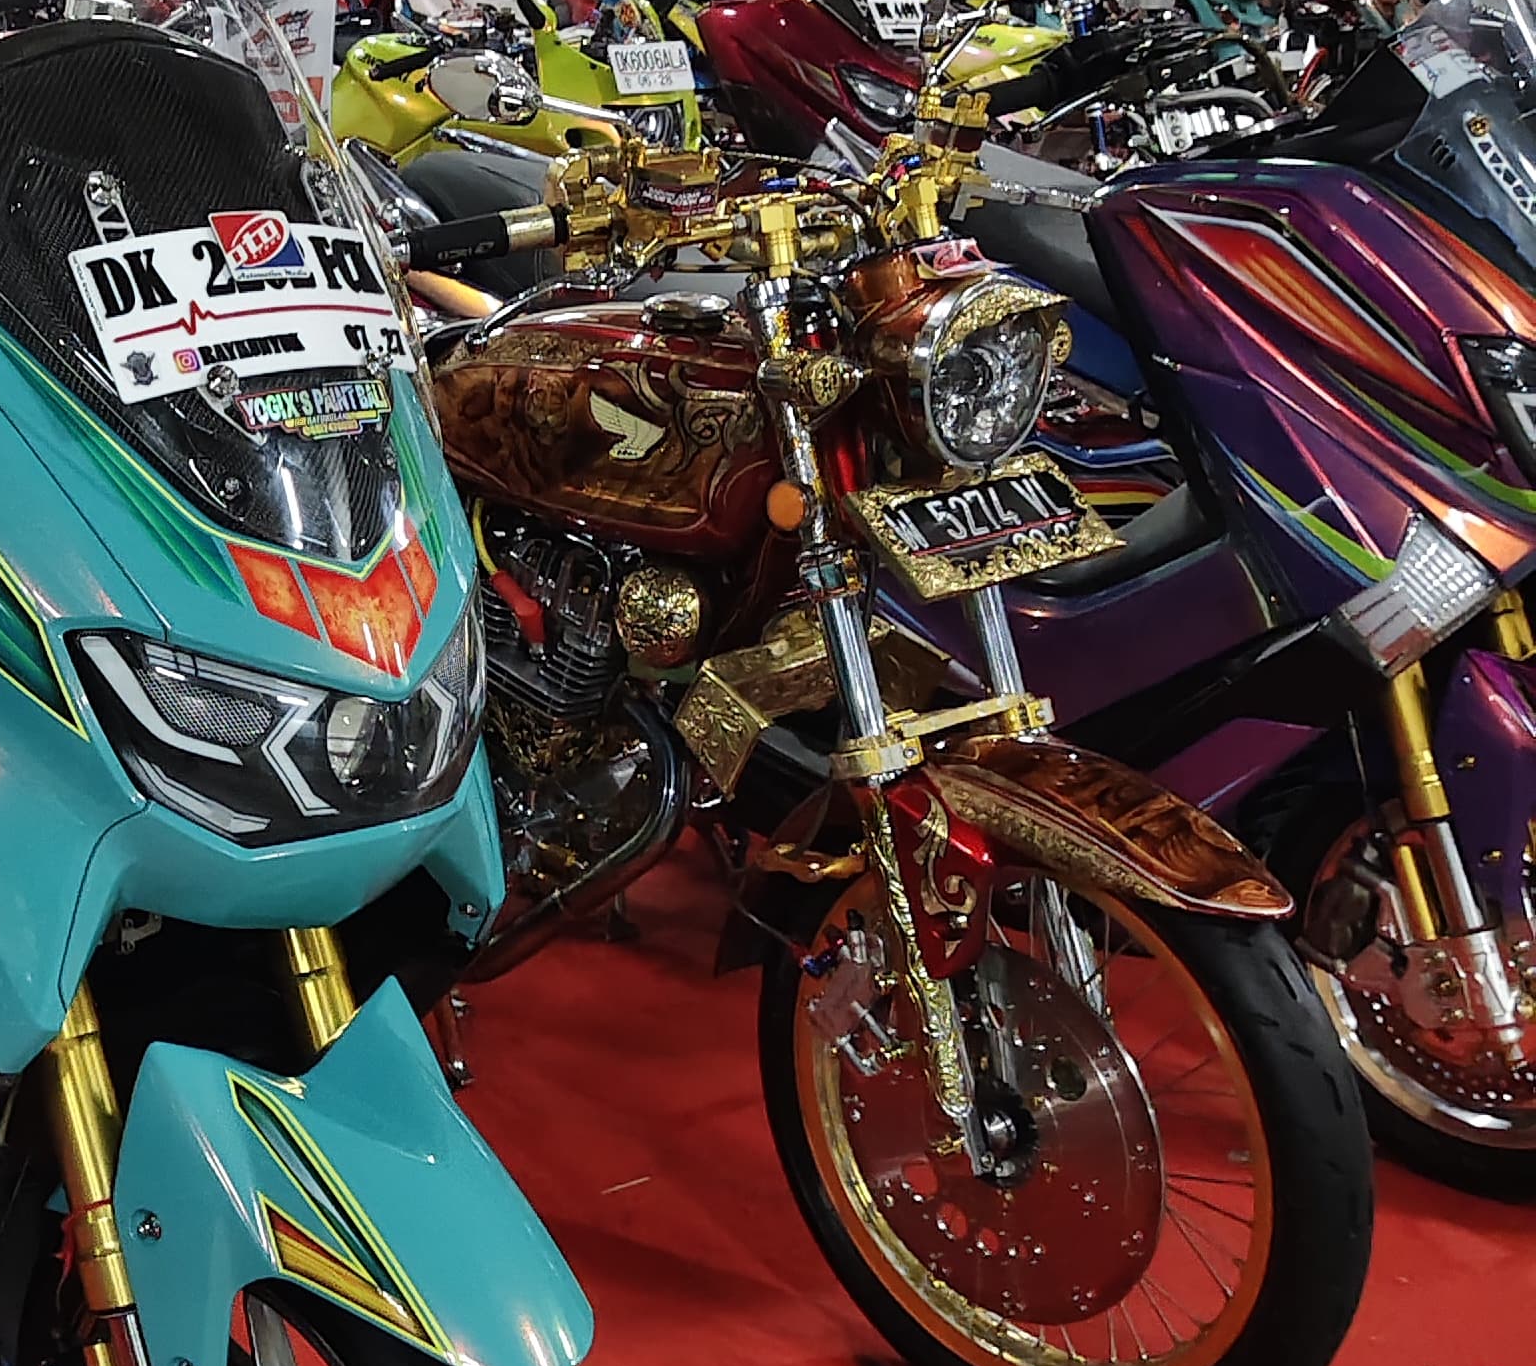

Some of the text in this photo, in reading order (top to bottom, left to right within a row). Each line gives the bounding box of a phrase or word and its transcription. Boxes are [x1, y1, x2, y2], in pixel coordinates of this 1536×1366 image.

[86, 248, 177, 318] DK
[924, 486, 1023, 541] 5274
[1010, 475, 1073, 519] VL
